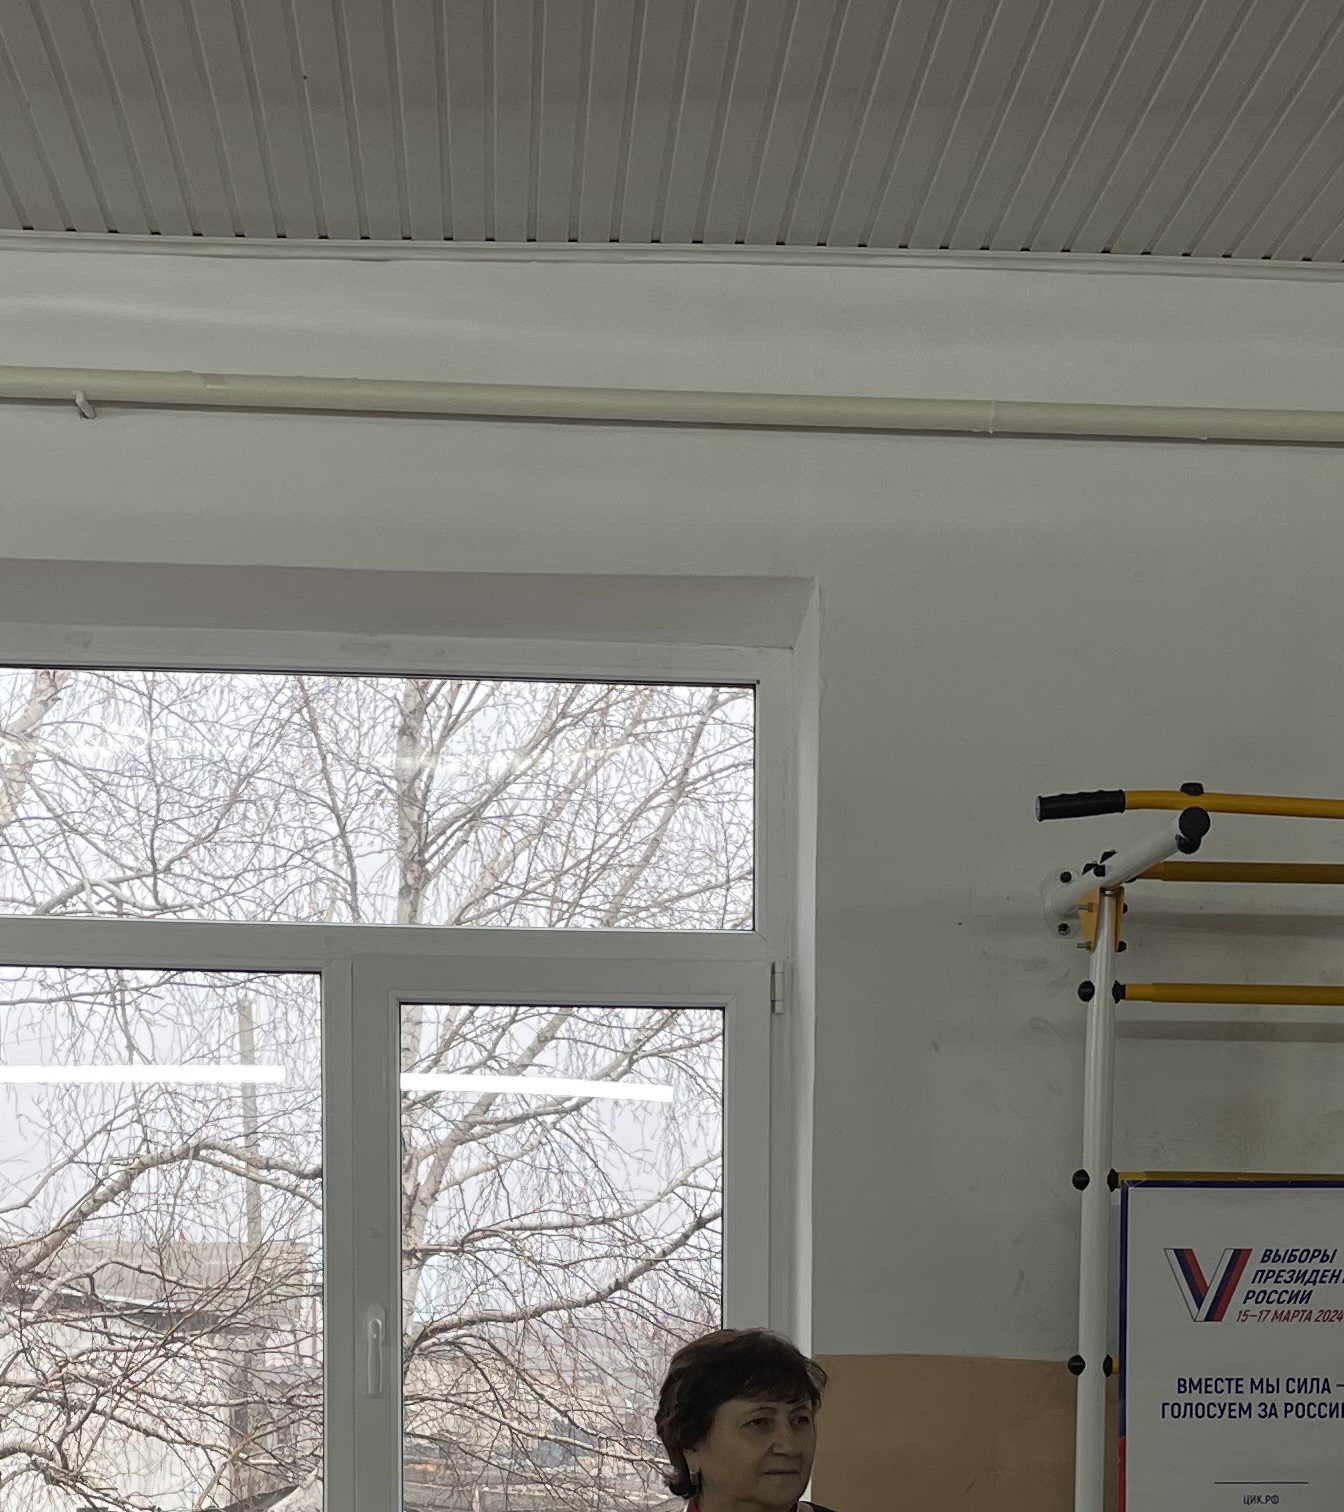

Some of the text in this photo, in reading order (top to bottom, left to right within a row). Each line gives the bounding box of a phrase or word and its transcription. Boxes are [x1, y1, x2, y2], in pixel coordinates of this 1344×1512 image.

[1260, 1248, 1337, 1264] ВЫБОРЫ
[1243, 1289, 1312, 1305] РОССИИ
[1271, 1309, 1312, 1322] МАРТА
[1314, 1309, 1344, 1322] 2024
[1177, 1377, 1244, 1395] ВМЕСТЕ
[1250, 1377, 1280, 1395] МЫ
[1286, 1377, 1332, 1395] СИЛА
[1161, 1402, 1252, 1419] ГОЛОСУЕМ
[1257, 1402, 1278, 1419] ЗА
[1243, 1495, 1280, 1506] ЦИК.РФ
